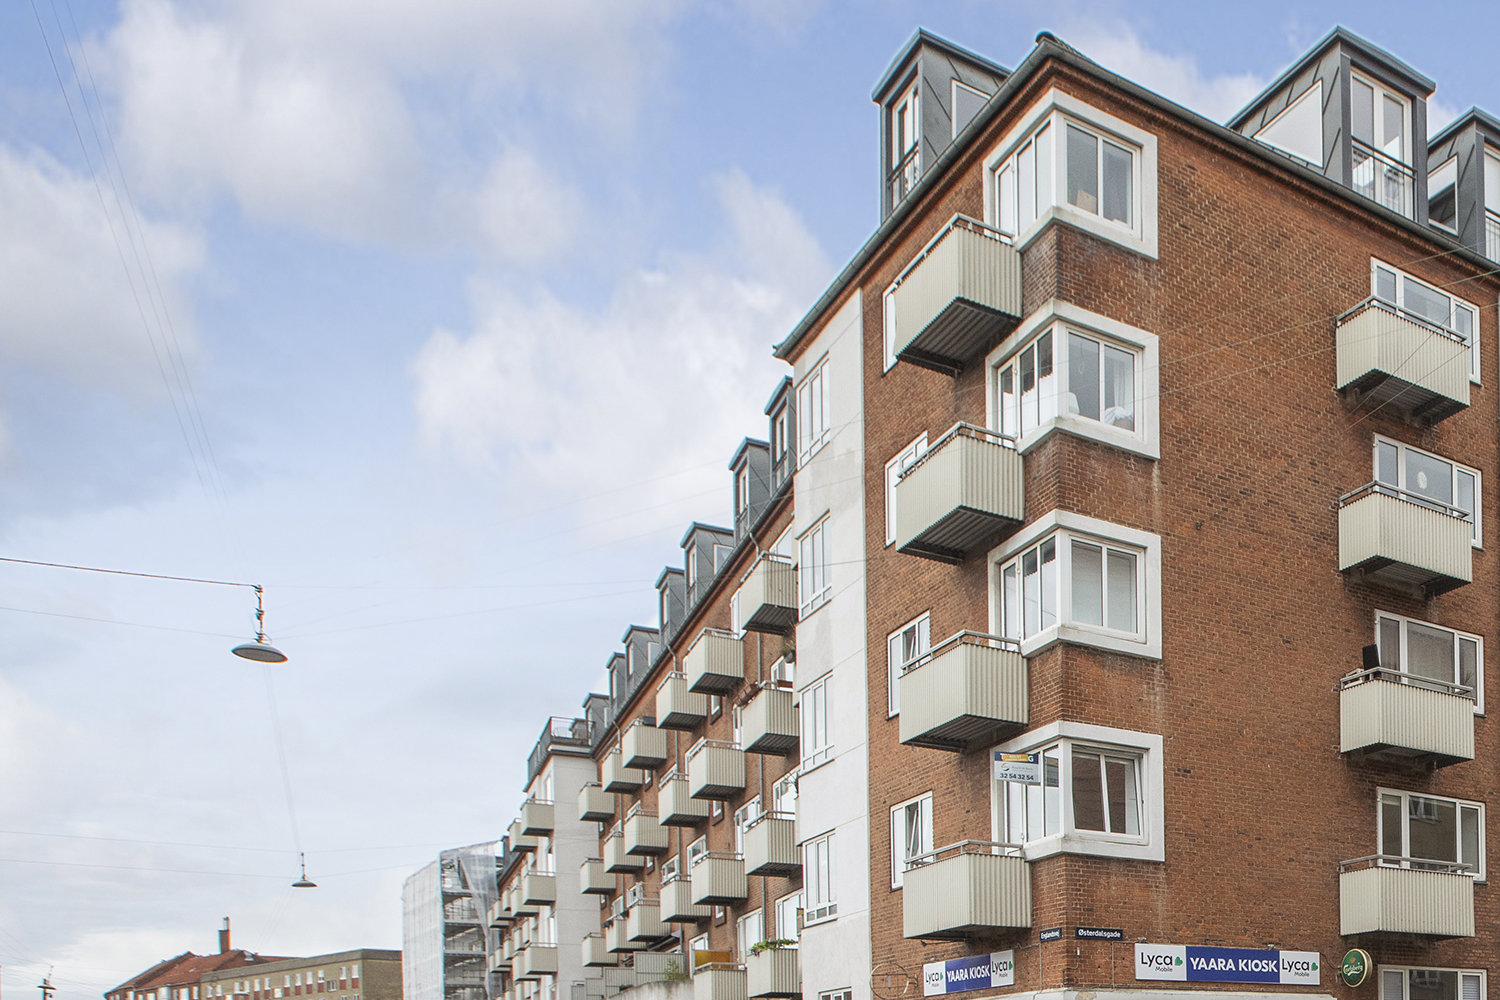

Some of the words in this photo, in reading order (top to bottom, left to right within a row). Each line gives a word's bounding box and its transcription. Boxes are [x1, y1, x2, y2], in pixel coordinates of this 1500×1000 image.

[1078, 929, 1121, 938] Østerdalsgade
[1140, 952, 1173, 967] Lyca
[1190, 957, 1236, 971] YAARA
[1238, 959, 1278, 973] KIOSK
[1281, 958, 1310, 973] Lyca
[946, 968, 969, 983] YAARA
[969, 964, 991, 979] KIOSK
[991, 961, 1008, 975] Lyca
[926, 971, 939, 985] Lyca
